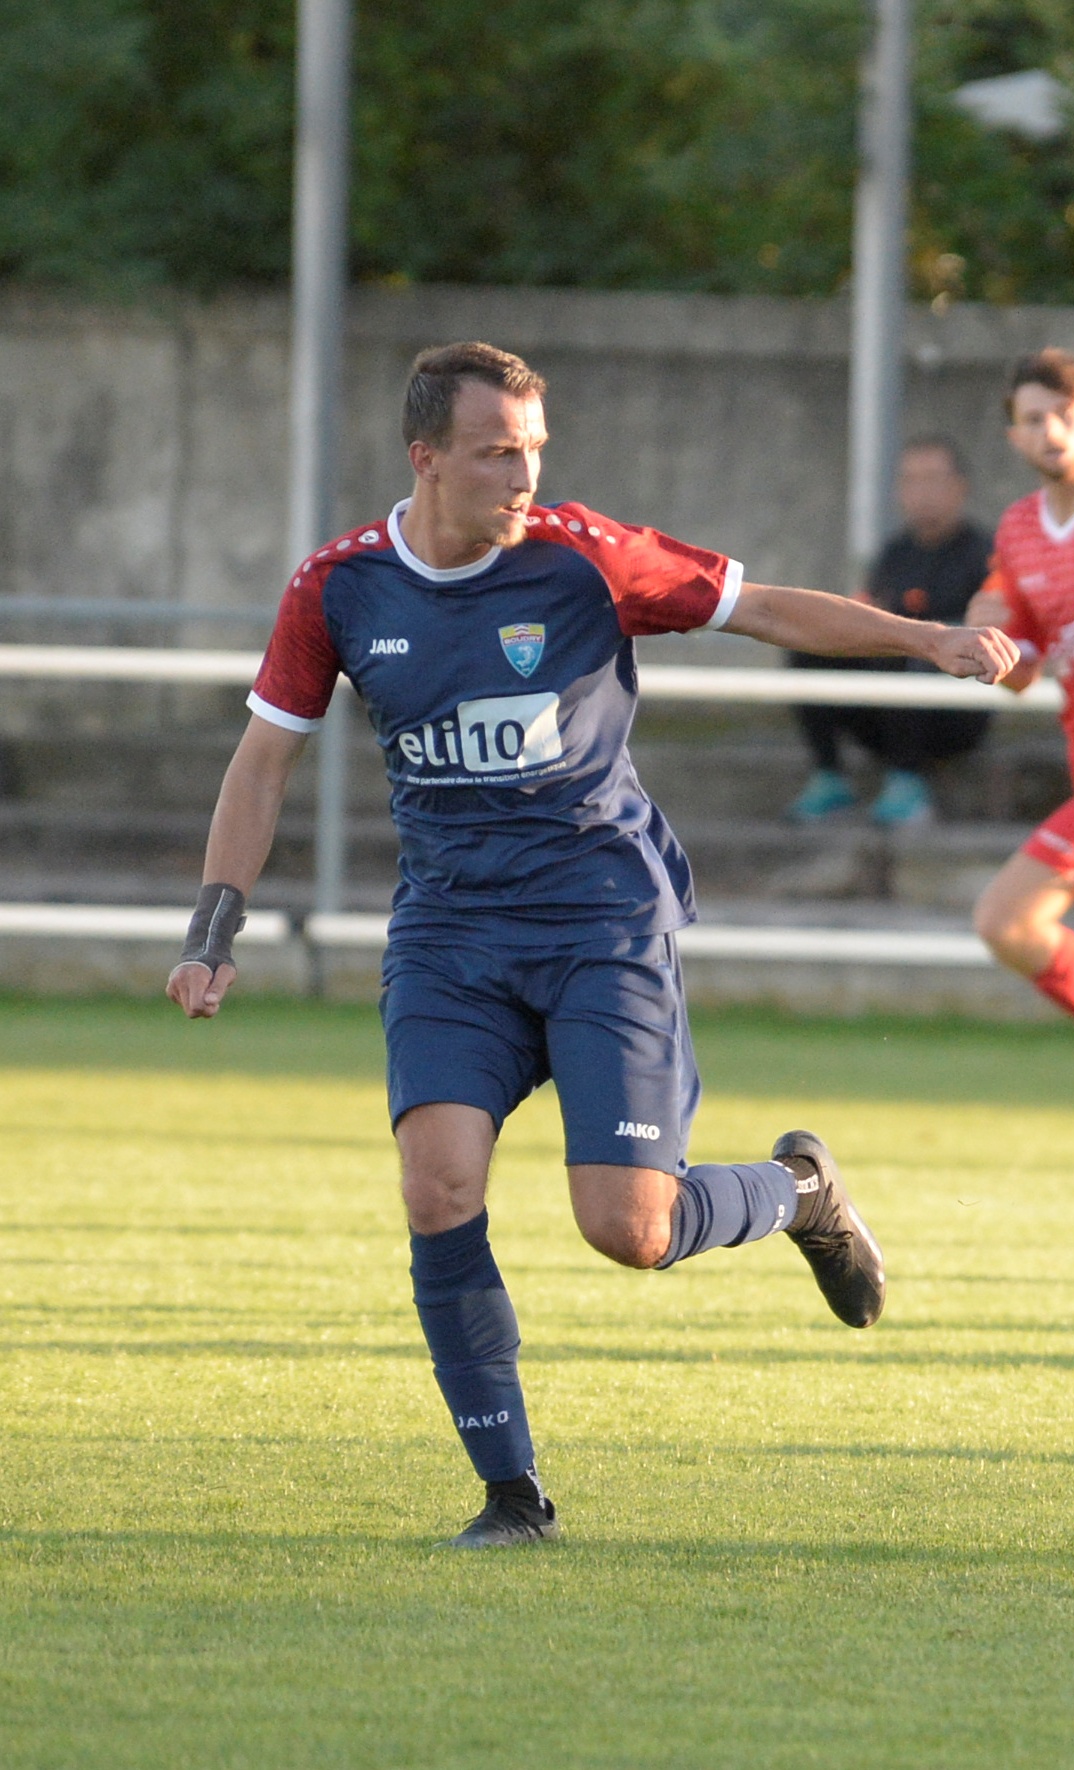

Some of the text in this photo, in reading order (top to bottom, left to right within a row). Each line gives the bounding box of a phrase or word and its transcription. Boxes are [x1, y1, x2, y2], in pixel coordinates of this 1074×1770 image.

[369, 638, 409, 654] JAKO
[504, 635, 542, 645] BOUDRY
[483, 773, 520, 783] transition
[615, 1121, 661, 1140] JAKO
[458, 1410, 509, 1429] JAKO
